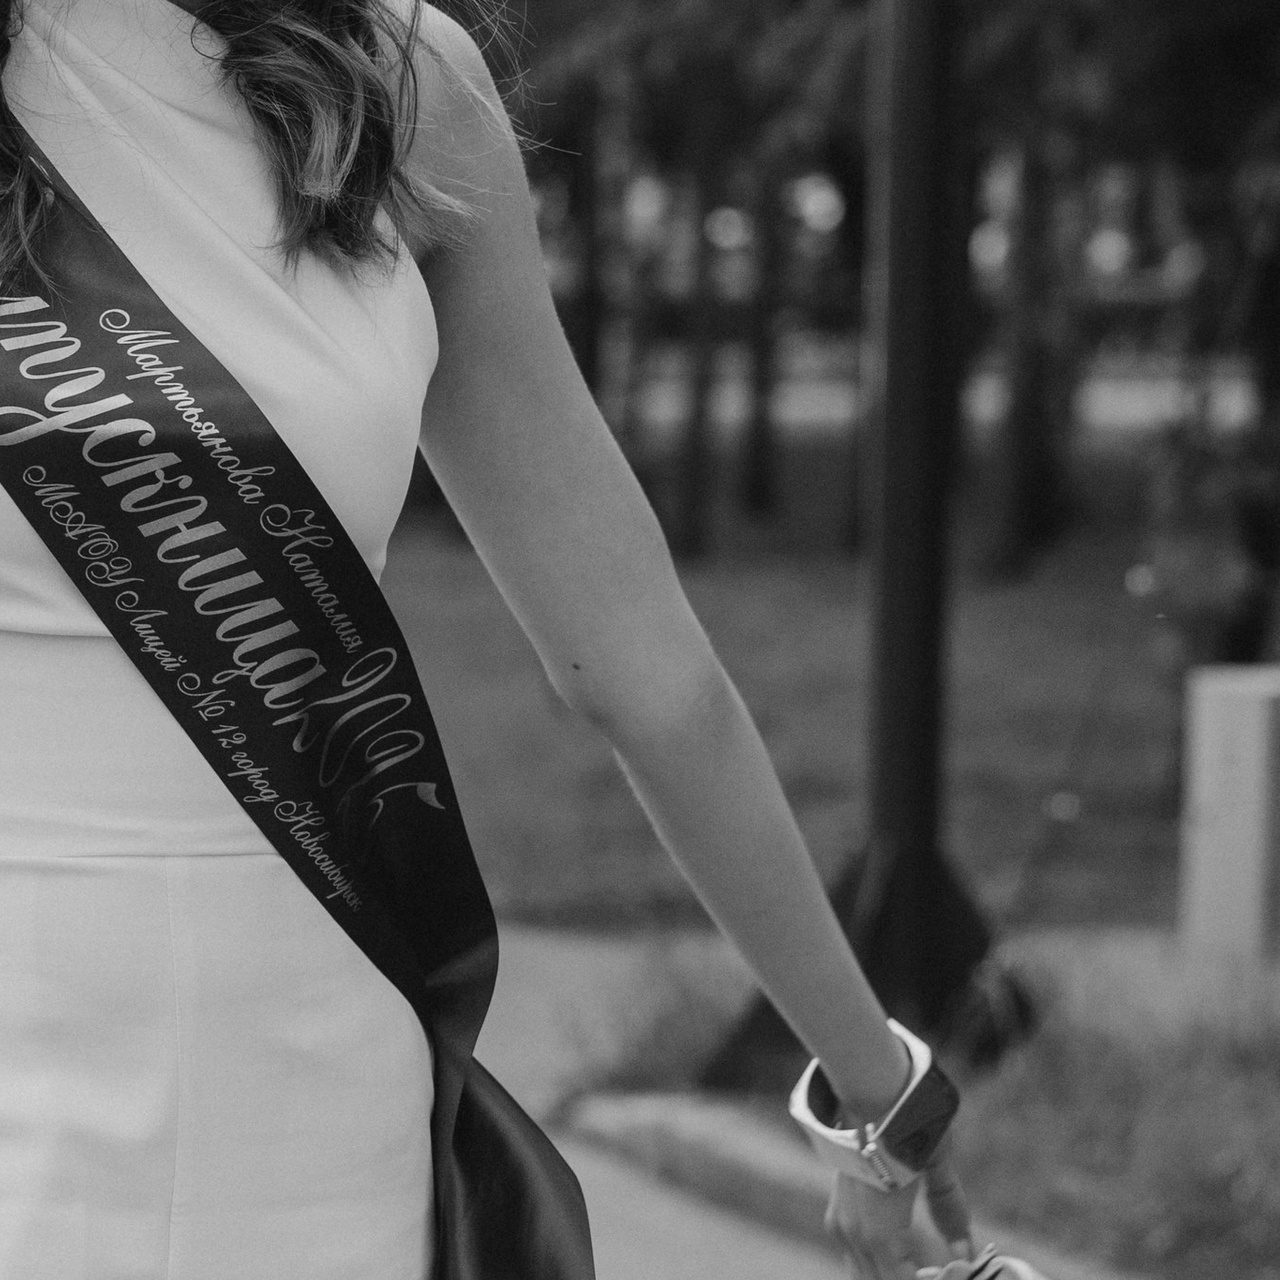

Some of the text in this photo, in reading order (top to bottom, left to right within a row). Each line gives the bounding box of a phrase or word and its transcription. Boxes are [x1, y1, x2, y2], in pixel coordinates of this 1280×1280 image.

[98, 308, 364, 654] Мартьянова Наталия
[21, 464, 145, 588] МАОУ
[114, 589, 188, 672] Лицей
[211, 723, 247, 750] 12
[226, 750, 280, 804] город
